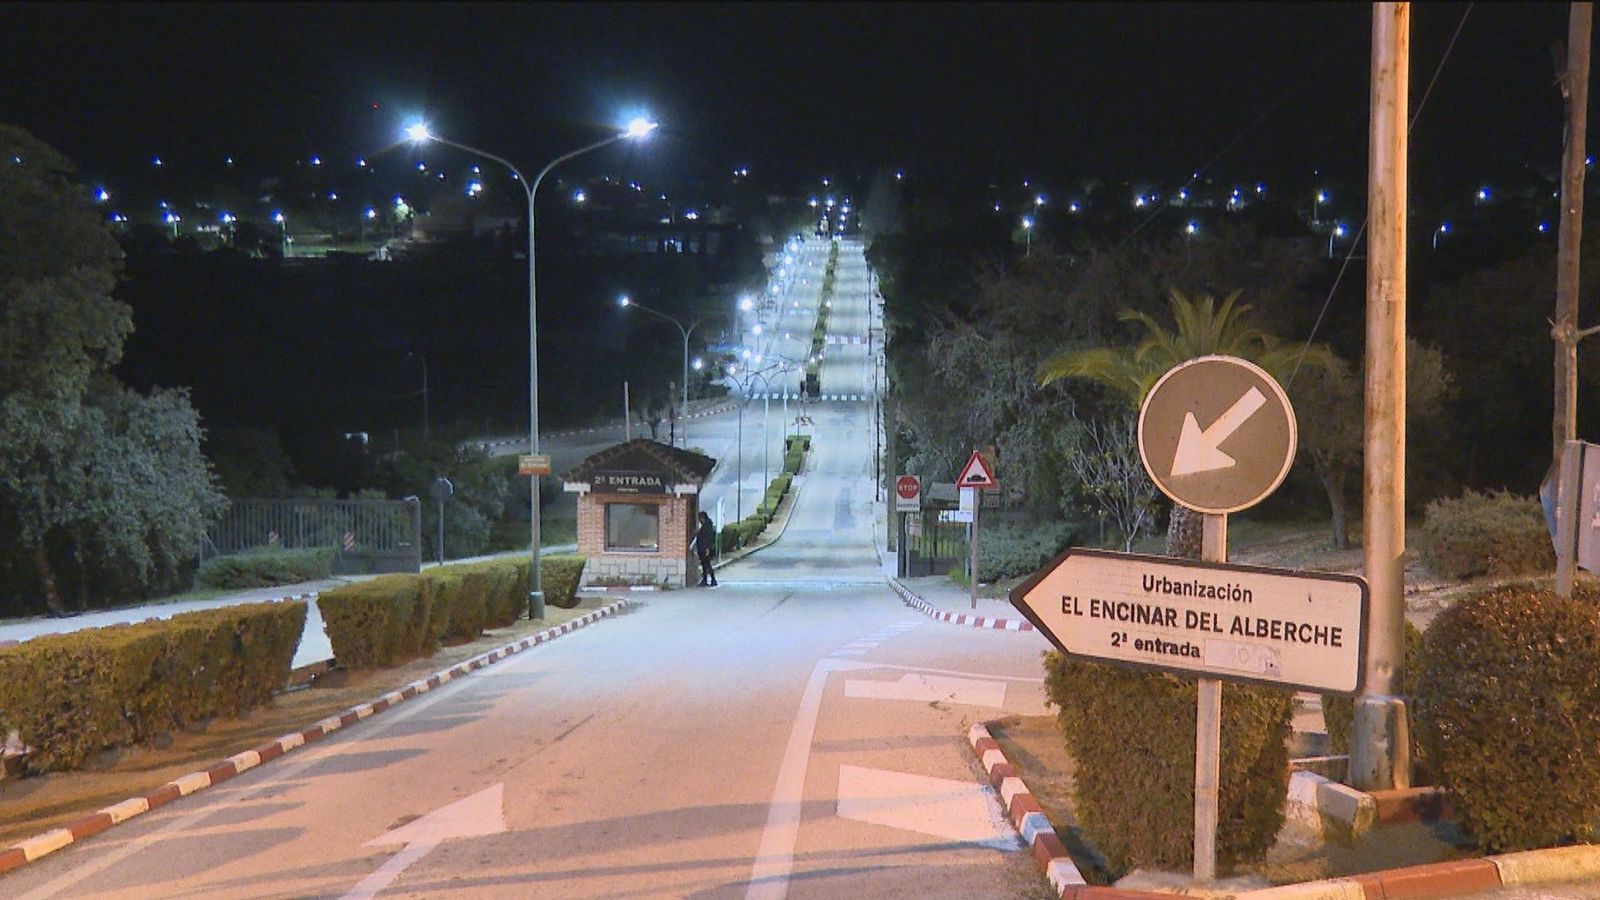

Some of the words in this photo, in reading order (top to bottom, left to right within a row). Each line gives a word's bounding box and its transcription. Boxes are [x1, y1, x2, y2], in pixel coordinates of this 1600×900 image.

[609, 476, 662, 487] ENTRADA
[1143, 574, 1253, 603] Urbanización
[1062, 595, 1083, 616] EL
[1090, 599, 1177, 627] ENCINAR
[1186, 610, 1223, 633] DEL
[1230, 615, 1342, 648] ALBERCHE
[1134, 638, 1200, 658] entrada
